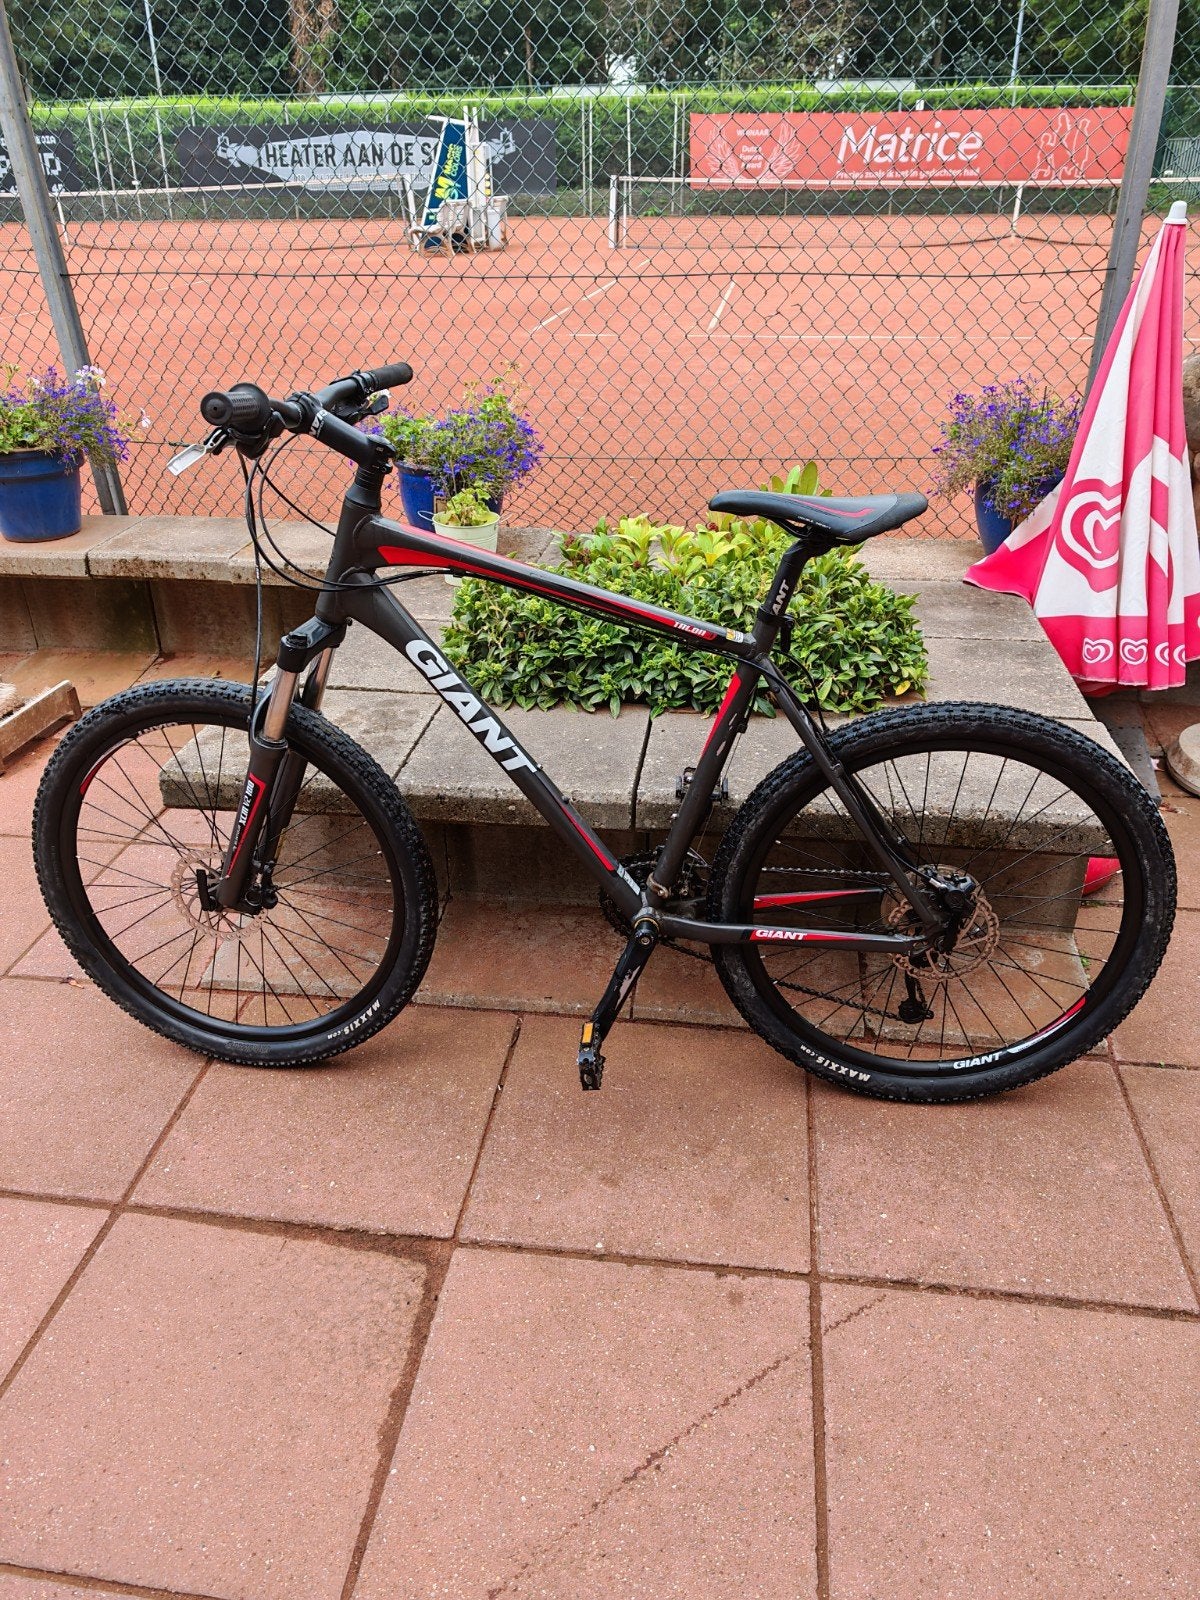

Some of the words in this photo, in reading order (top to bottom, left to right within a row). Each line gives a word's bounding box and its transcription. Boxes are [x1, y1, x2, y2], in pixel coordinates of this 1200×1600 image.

[35, 135, 57, 145] EDIA
[837, 120, 983, 163] Matrice
[343, 143, 384, 167] AAN
[421, 142, 439, 166] S
[405, 639, 538, 773] GIANT
[755, 929, 808, 941] GIANT
[953, 1051, 1003, 1070] GIANT
